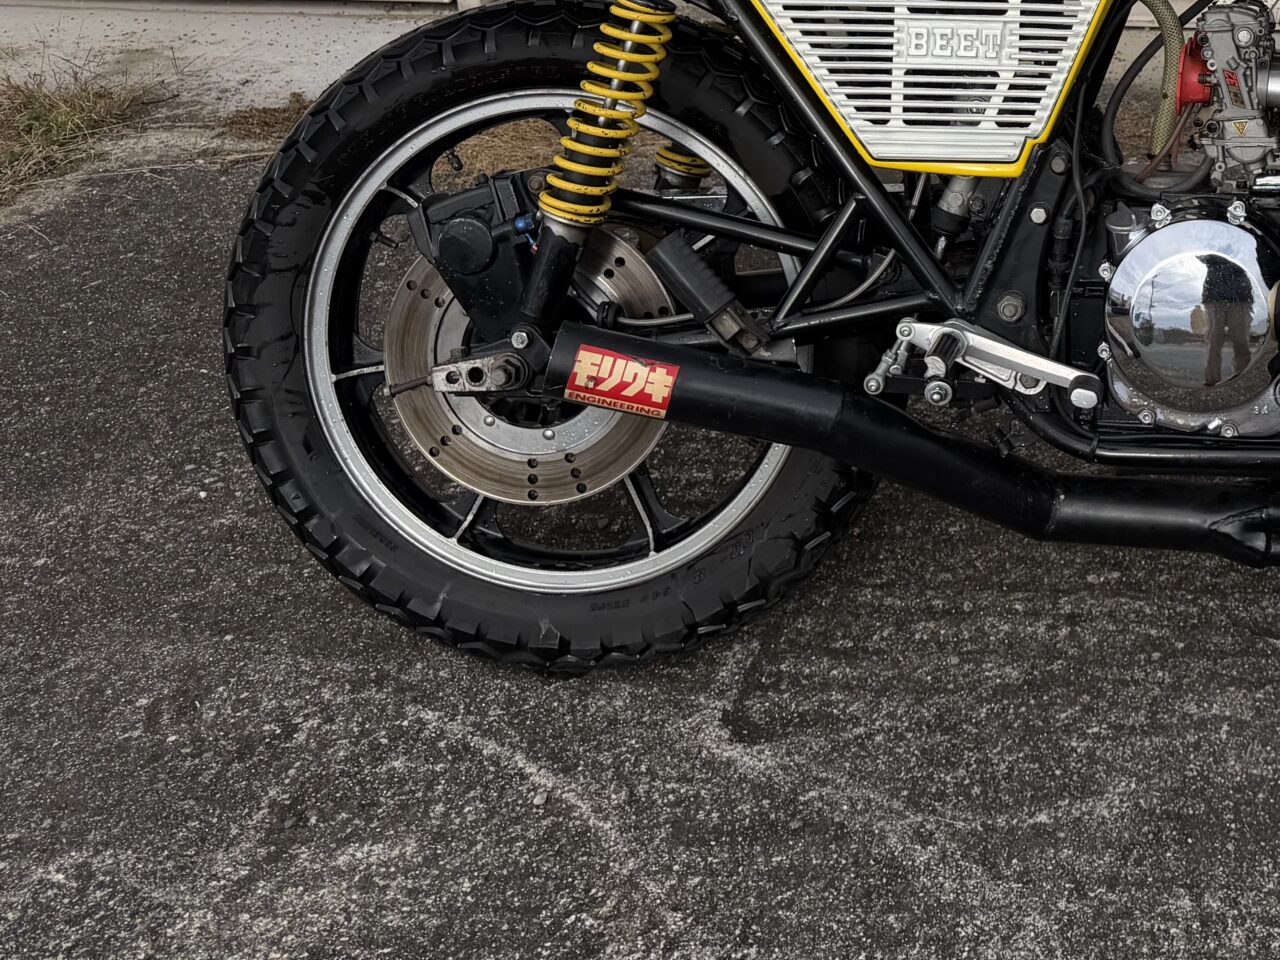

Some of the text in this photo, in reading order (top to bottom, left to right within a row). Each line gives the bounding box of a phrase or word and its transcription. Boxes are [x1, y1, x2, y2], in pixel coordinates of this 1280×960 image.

[908, 27, 1002, 58] BEET
[573, 350, 673, 403] モリワキ
[567, 391, 661, 417] ENGINEERING
